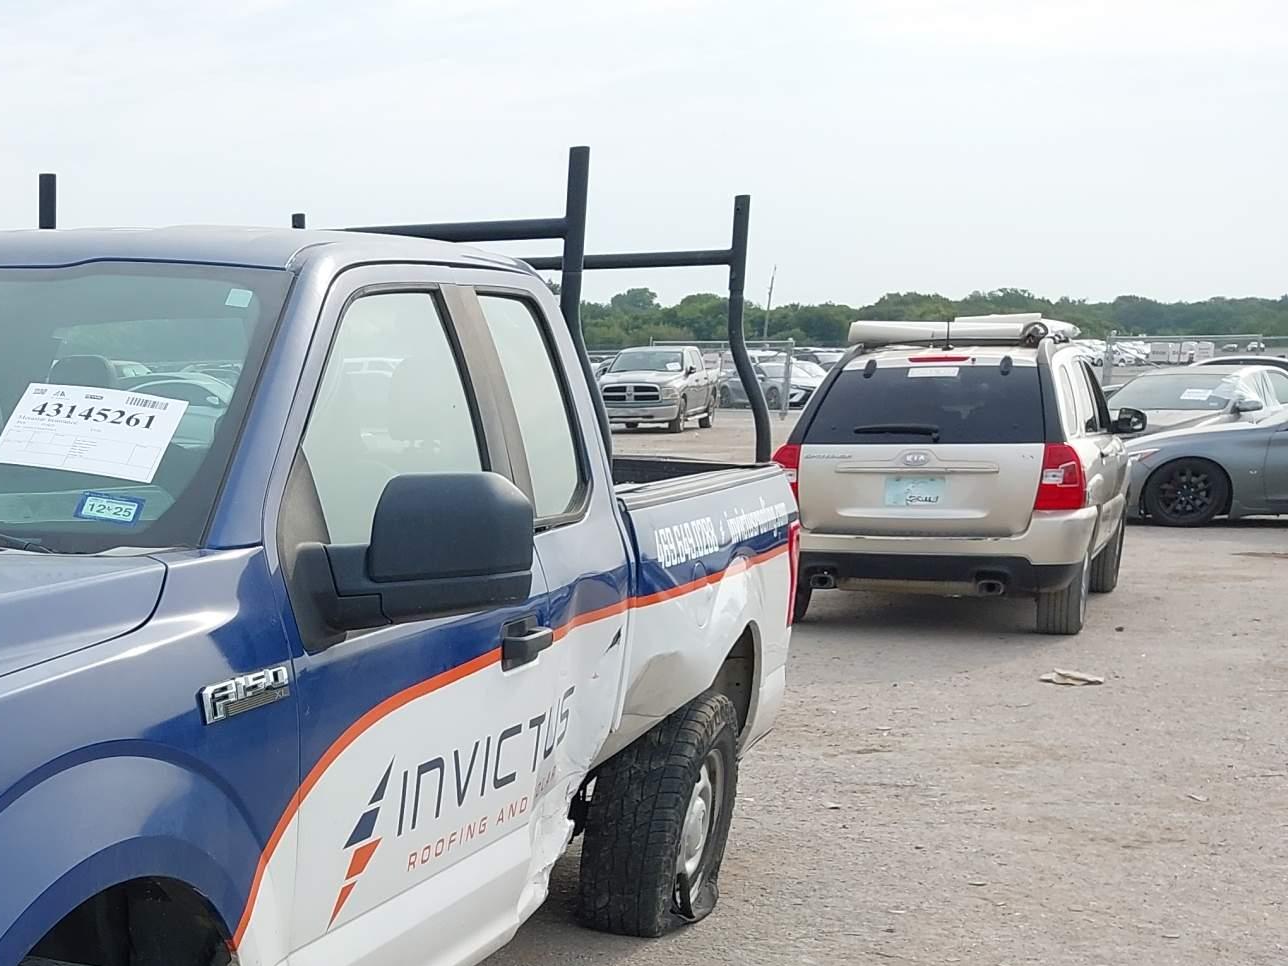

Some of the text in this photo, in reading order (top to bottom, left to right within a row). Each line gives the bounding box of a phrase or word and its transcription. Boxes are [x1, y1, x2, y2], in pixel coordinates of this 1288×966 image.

[32, 401, 156, 430] 43145261
[396, 685, 576, 838] INVICTUS
[406, 815, 489, 873] ROOFING
[496, 796, 529, 827] AND
